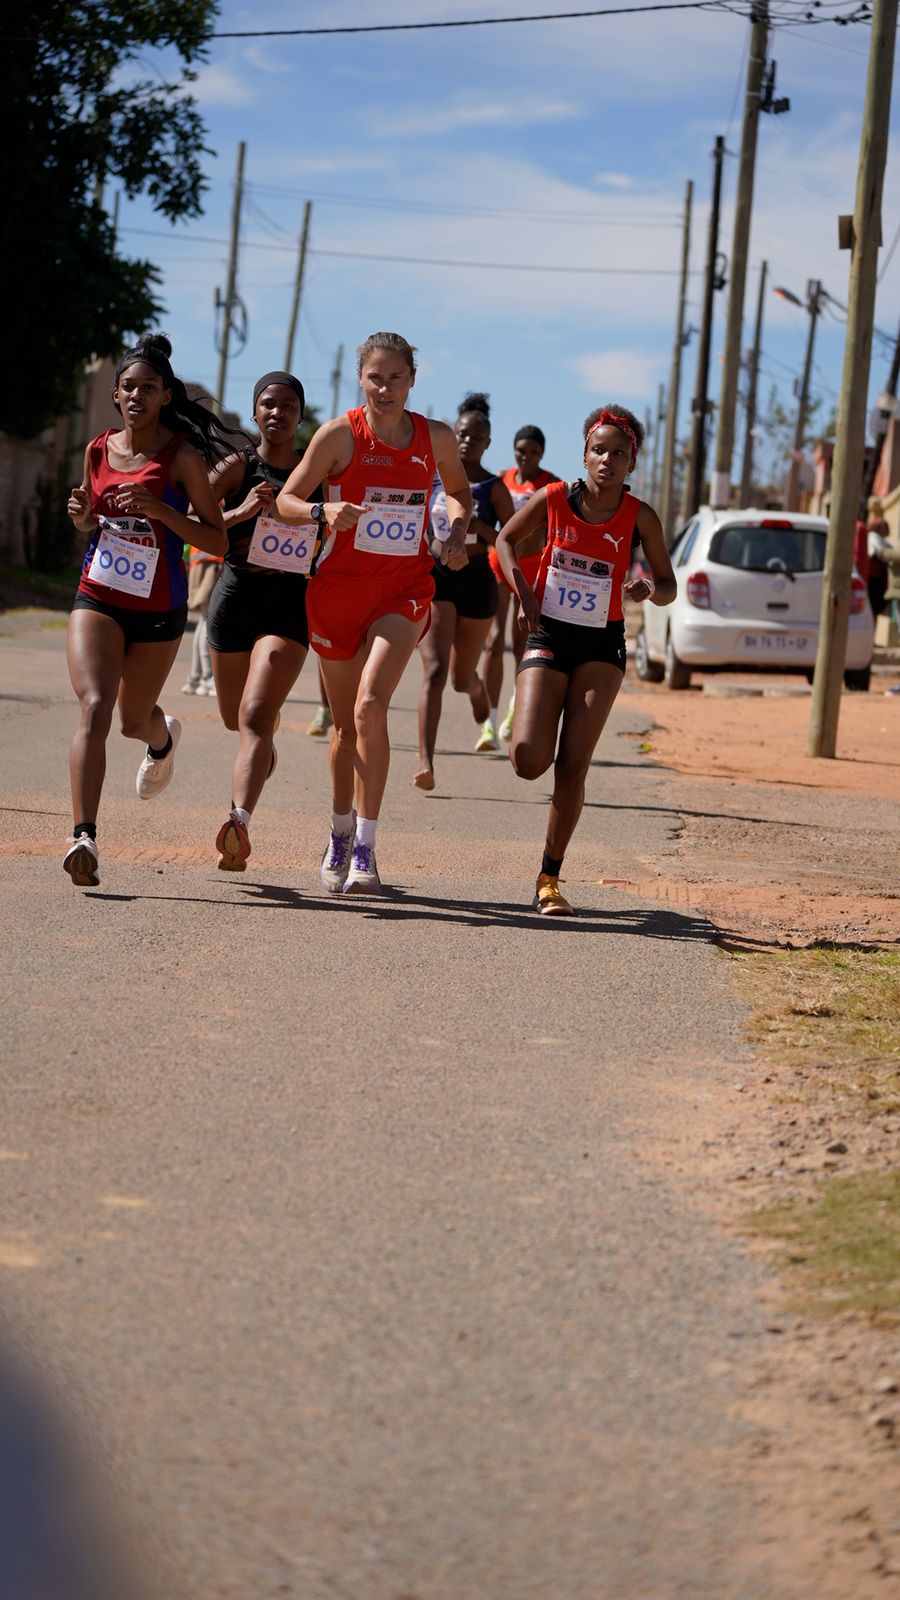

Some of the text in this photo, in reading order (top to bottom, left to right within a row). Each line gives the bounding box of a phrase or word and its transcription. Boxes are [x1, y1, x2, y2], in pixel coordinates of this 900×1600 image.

[387, 494, 405, 502] 2026
[366, 519, 417, 541] 005
[262, 535, 308, 558] 066
[99, 549, 147, 581] 008
[571, 558, 587, 570] 2026
[558, 587, 597, 612] 193
